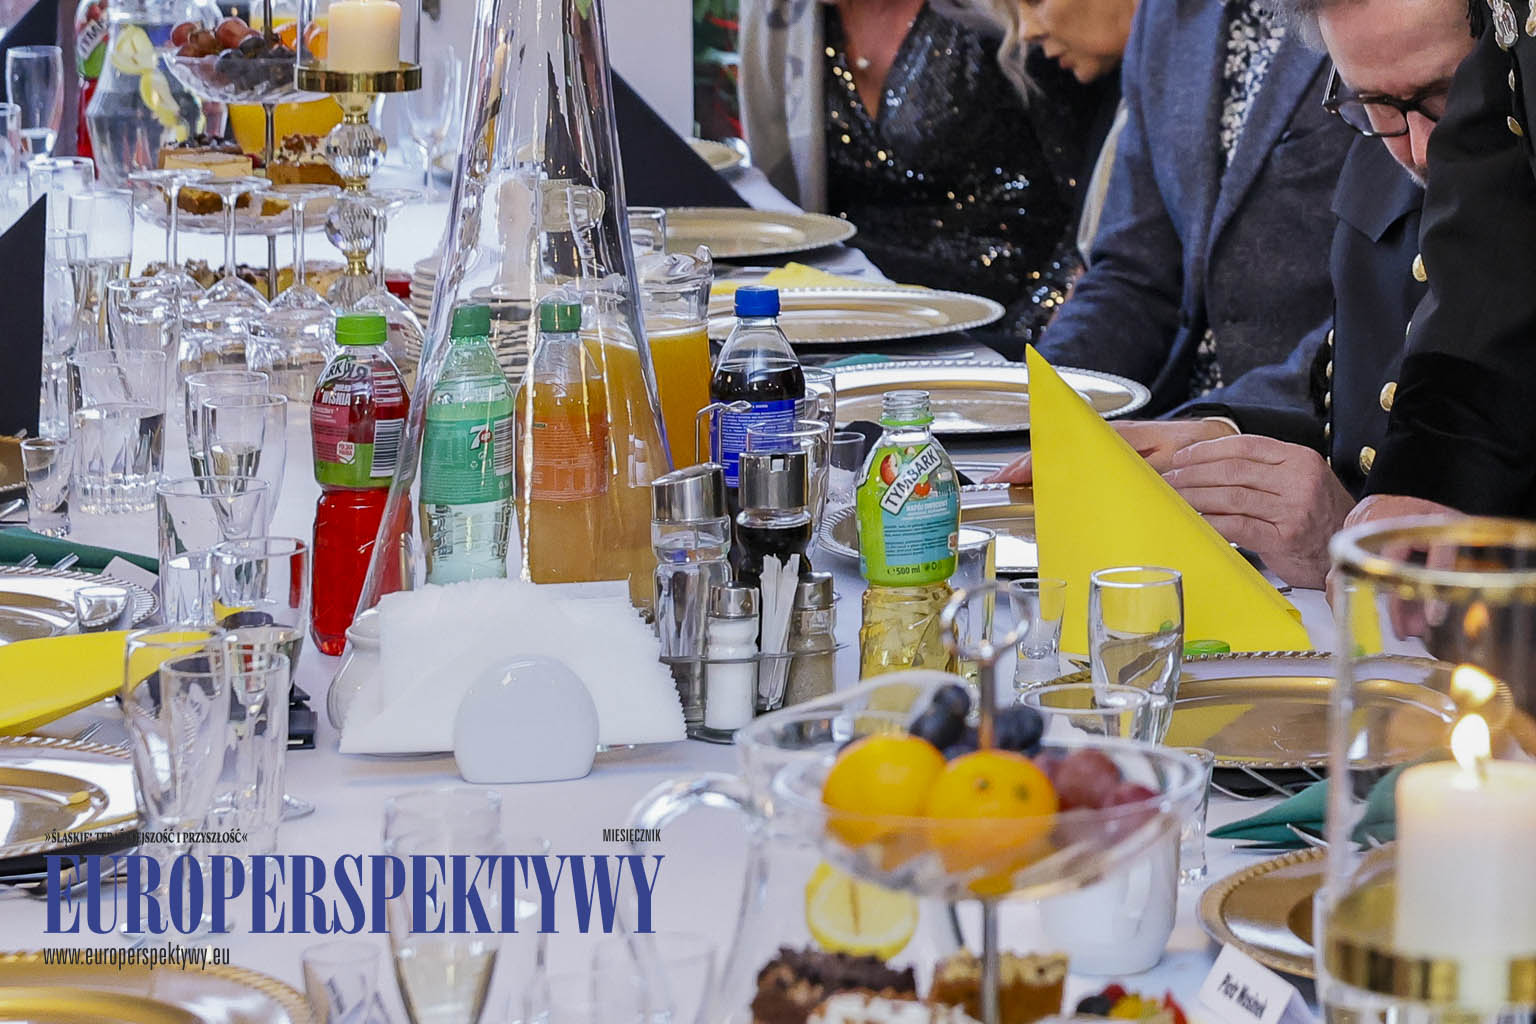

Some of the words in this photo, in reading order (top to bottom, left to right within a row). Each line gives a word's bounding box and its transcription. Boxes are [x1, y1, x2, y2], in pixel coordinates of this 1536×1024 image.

[884, 447, 939, 506] TYMBARK
[896, 567, 910, 576] 500
[911, 564, 921, 574] ml
